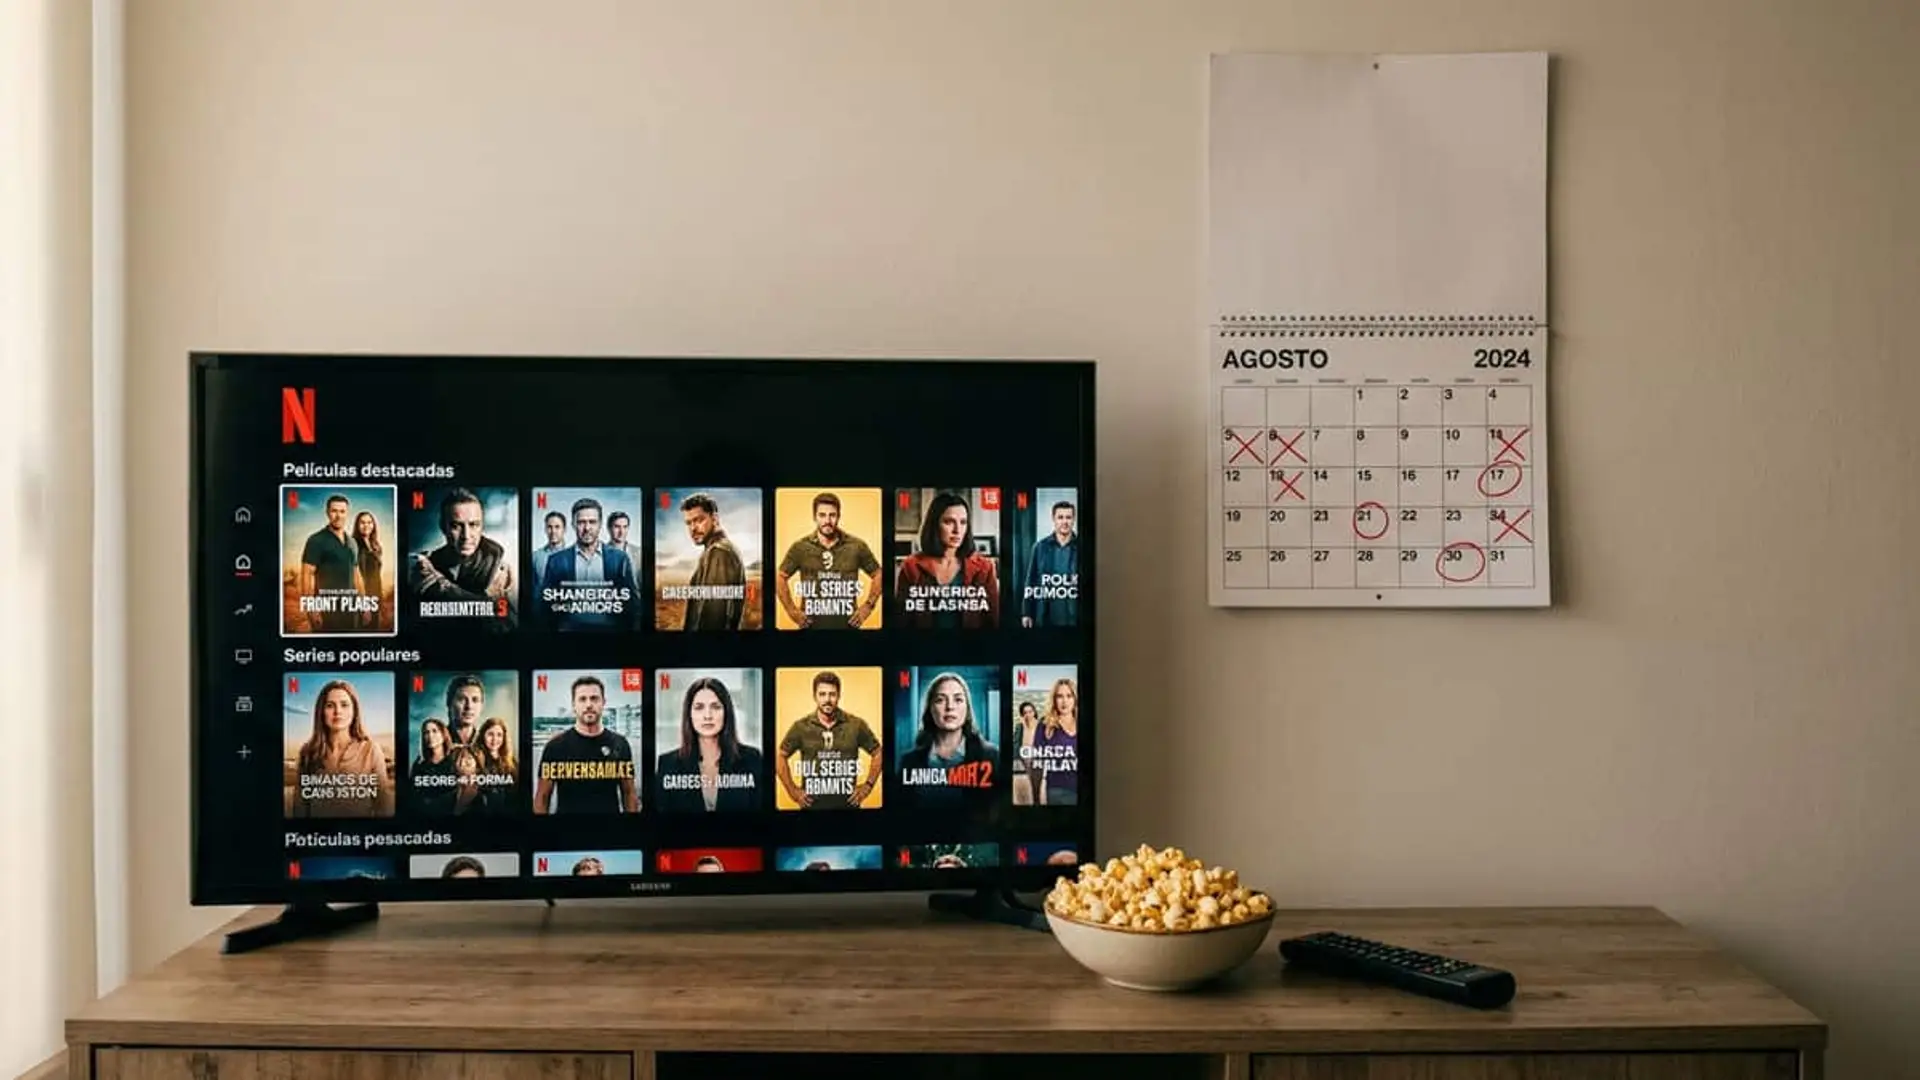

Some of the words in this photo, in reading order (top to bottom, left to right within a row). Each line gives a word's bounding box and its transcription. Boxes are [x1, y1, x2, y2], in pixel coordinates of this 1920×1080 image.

[1221, 348, 1329, 370] AGOSTO
[1473, 347, 1532, 369] 2024
[1357, 388, 1364, 400] 1
[1400, 388, 1409, 400] 2
[1445, 388, 1453, 400] 3
[1488, 388, 1497, 400] 4
[282, 387, 315, 443] N
[1313, 429, 1321, 441] 7
[1357, 429, 1365, 441] 8
[1400, 429, 1409, 441] 9
[1445, 429, 1460, 441] 10
[283, 462, 358, 478] Películas
[360, 462, 455, 478] destacadas
[1225, 470, 1241, 481] 12
[1313, 470, 1328, 481] 14
[1357, 470, 1372, 481] 15
[1401, 470, 1416, 481] 16
[1446, 470, 1460, 481] 17
[1490, 469, 1504, 480] 17
[1226, 510, 1241, 522] 19
[1269, 510, 1286, 522] 20
[1357, 510, 1371, 521] 21
[1401, 510, 1417, 521] 22
[1446, 510, 1461, 521] 23
[1226, 550, 1242, 562] 25
[1269, 550, 1286, 562] 26
[1313, 550, 1330, 562] 27
[1357, 550, 1373, 562] 28
[1401, 550, 1417, 562] 29
[1446, 550, 1462, 561] 30
[1490, 550, 1505, 561] 31
[299, 596, 338, 612] FRONT
[905, 600, 926, 611] DE
[284, 647, 335, 662] Series
[339, 647, 420, 666] populares
[979, 760, 993, 788] 2
